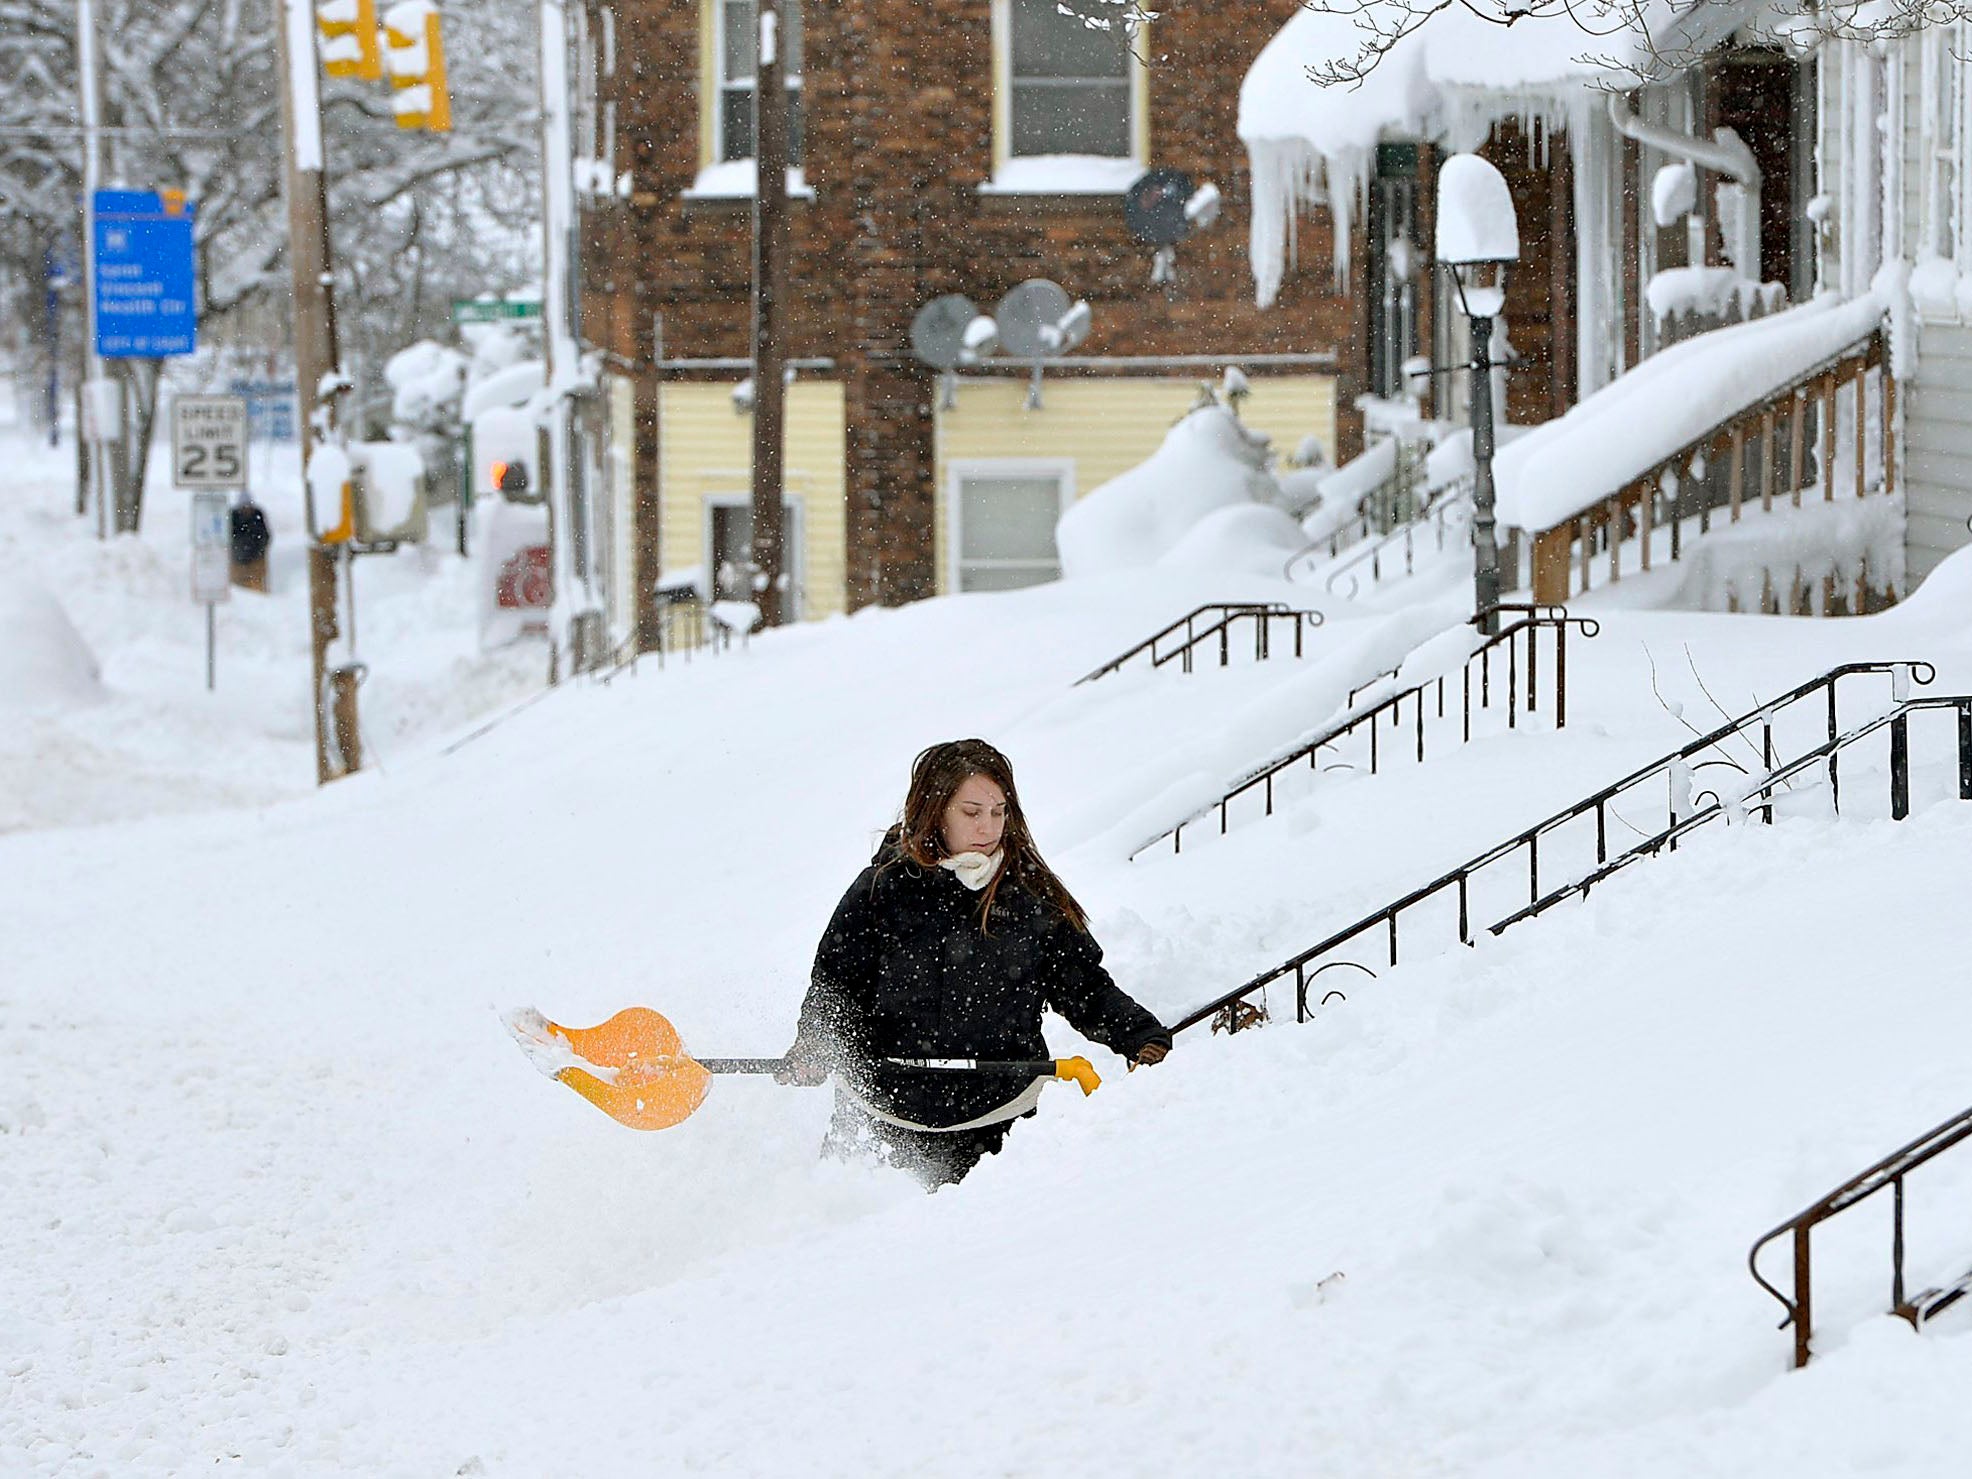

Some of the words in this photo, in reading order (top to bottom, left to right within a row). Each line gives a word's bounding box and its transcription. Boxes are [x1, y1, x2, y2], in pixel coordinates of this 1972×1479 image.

[181, 405, 239, 419] SPEED
[187, 425, 234, 439] LIMIT
[183, 444, 240, 477] 25
